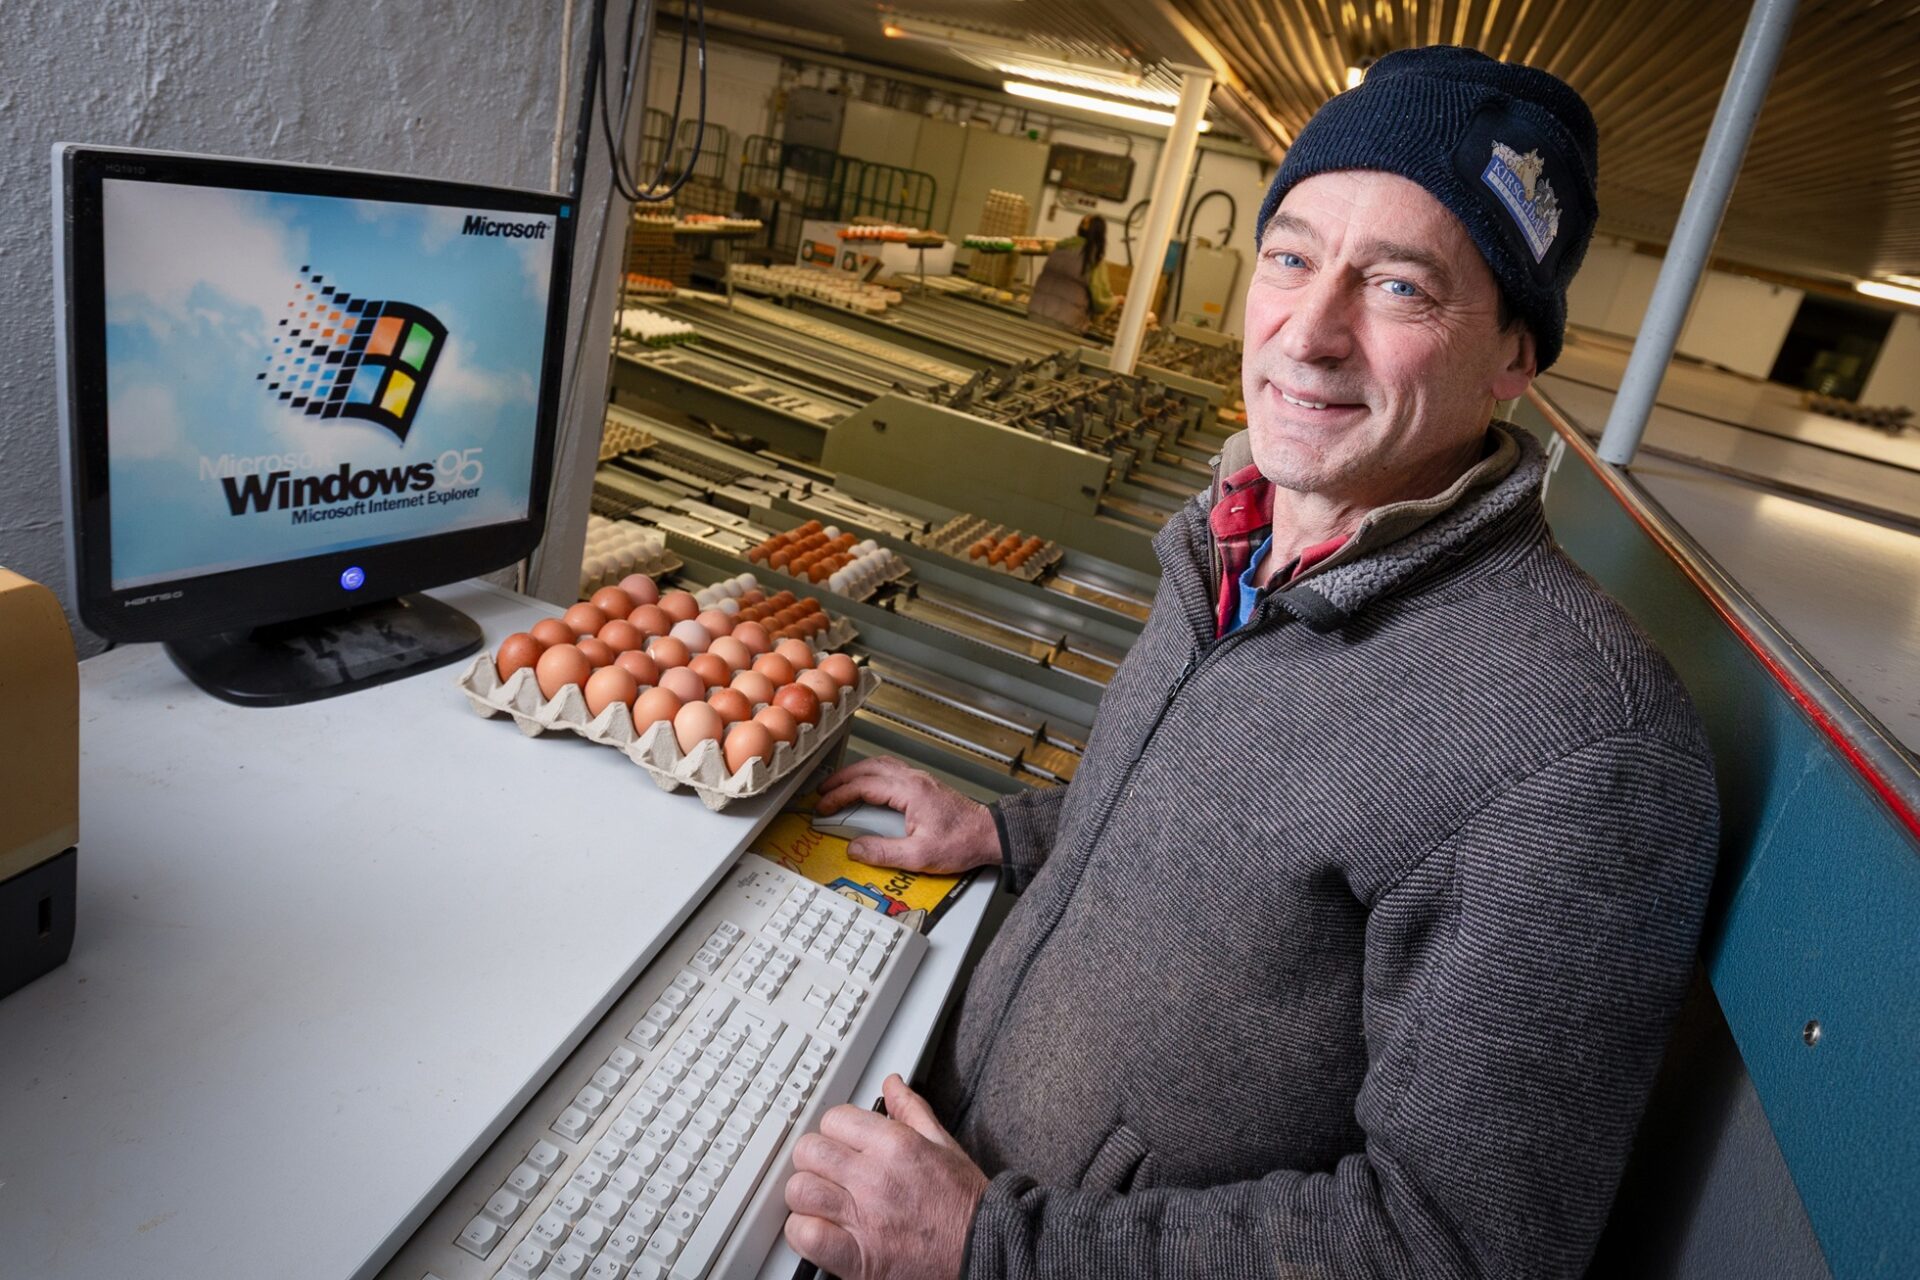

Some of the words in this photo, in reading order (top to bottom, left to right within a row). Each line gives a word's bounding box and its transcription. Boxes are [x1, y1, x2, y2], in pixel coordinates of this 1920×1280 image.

[462, 215, 547, 240] Microsoft
[200, 447, 334, 481] Microsoft
[221, 461, 436, 517] Windows
[436, 447, 484, 487] 95
[291, 501, 366, 525] Microsoft
[368, 493, 425, 514] Internet
[427, 485, 481, 506] Explorer
